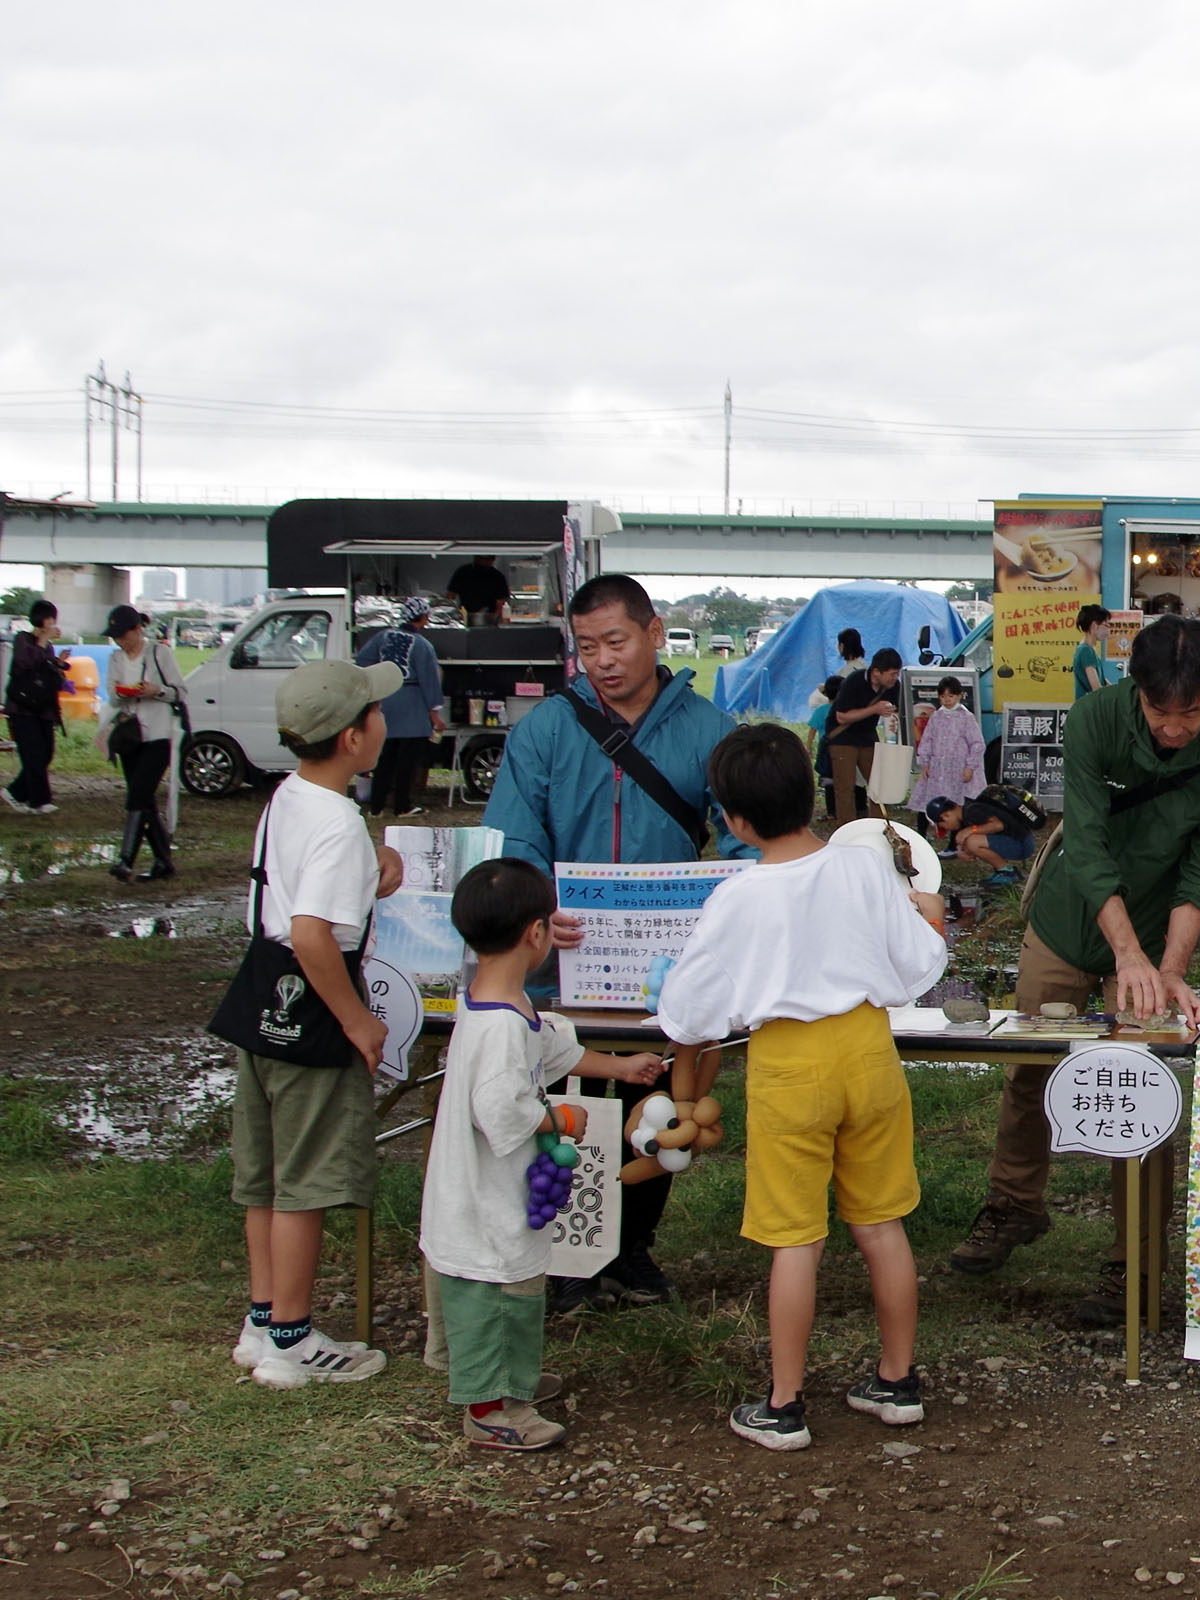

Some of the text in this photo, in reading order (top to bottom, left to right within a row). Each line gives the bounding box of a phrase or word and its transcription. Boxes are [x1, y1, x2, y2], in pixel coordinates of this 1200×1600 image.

[1005, 617, 1078, 637] 国産黒豚10
[1012, 716, 1053, 736] 黒豚
[565, 885, 605, 900] クイズ
[1073, 1066, 1160, 1088] ご自由に
[1072, 1092, 1136, 1113] お持ち
[1075, 1118, 1160, 1138] ください
